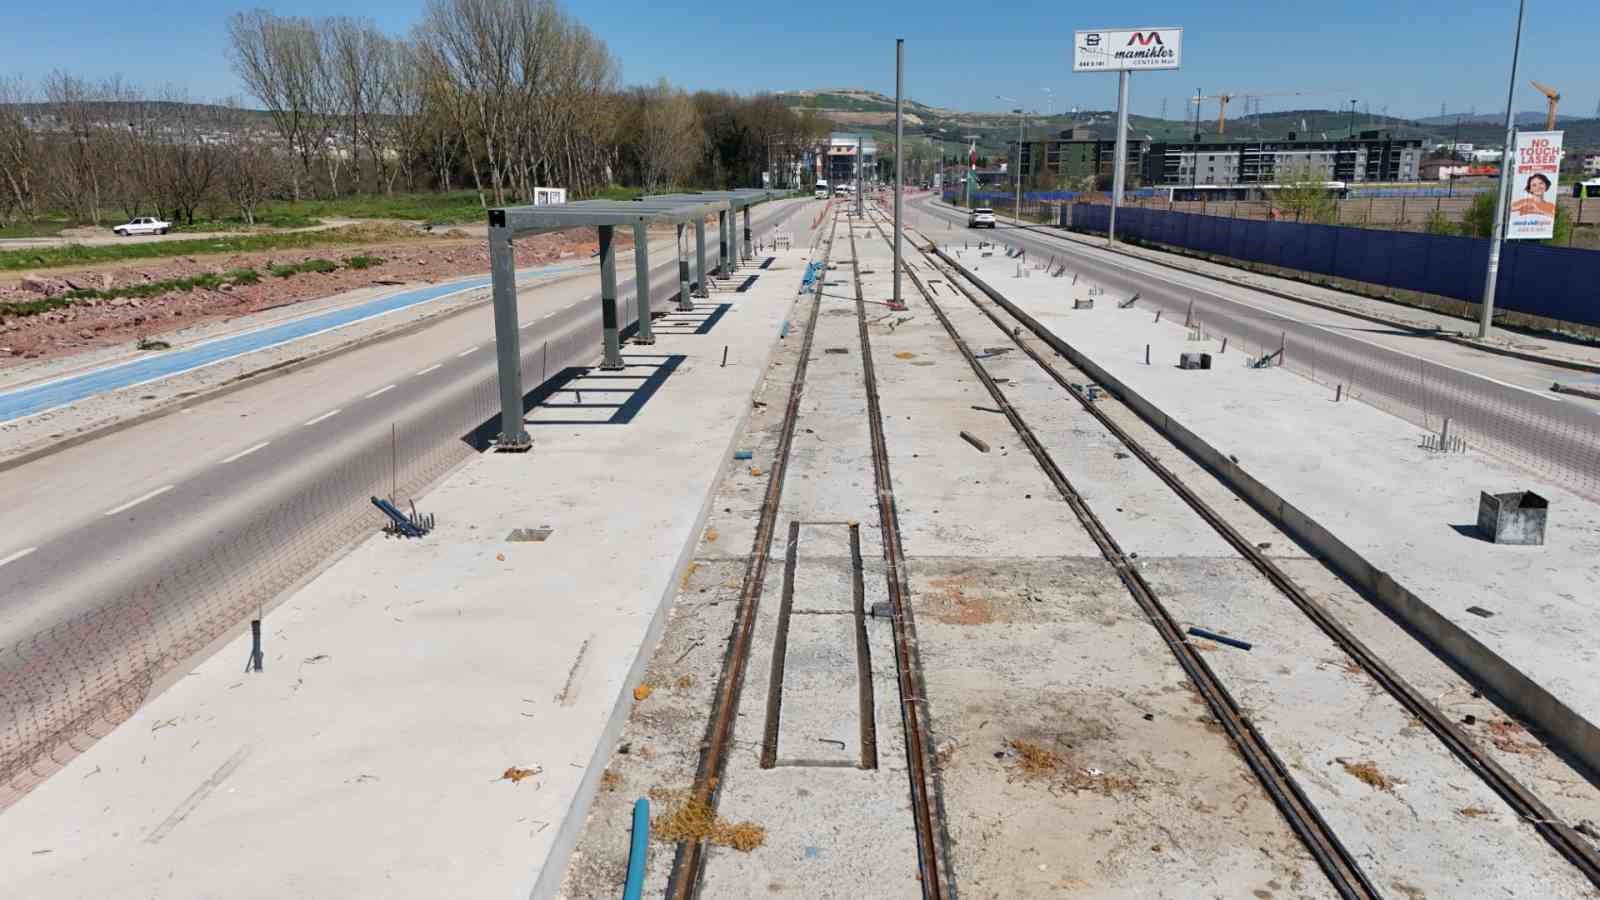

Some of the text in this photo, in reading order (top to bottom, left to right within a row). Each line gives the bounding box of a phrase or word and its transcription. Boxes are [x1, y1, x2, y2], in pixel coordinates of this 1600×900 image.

[1532, 138, 1549, 147] NO
[1520, 146, 1560, 156] TOUCH
[1521, 155, 1556, 164] LASER
